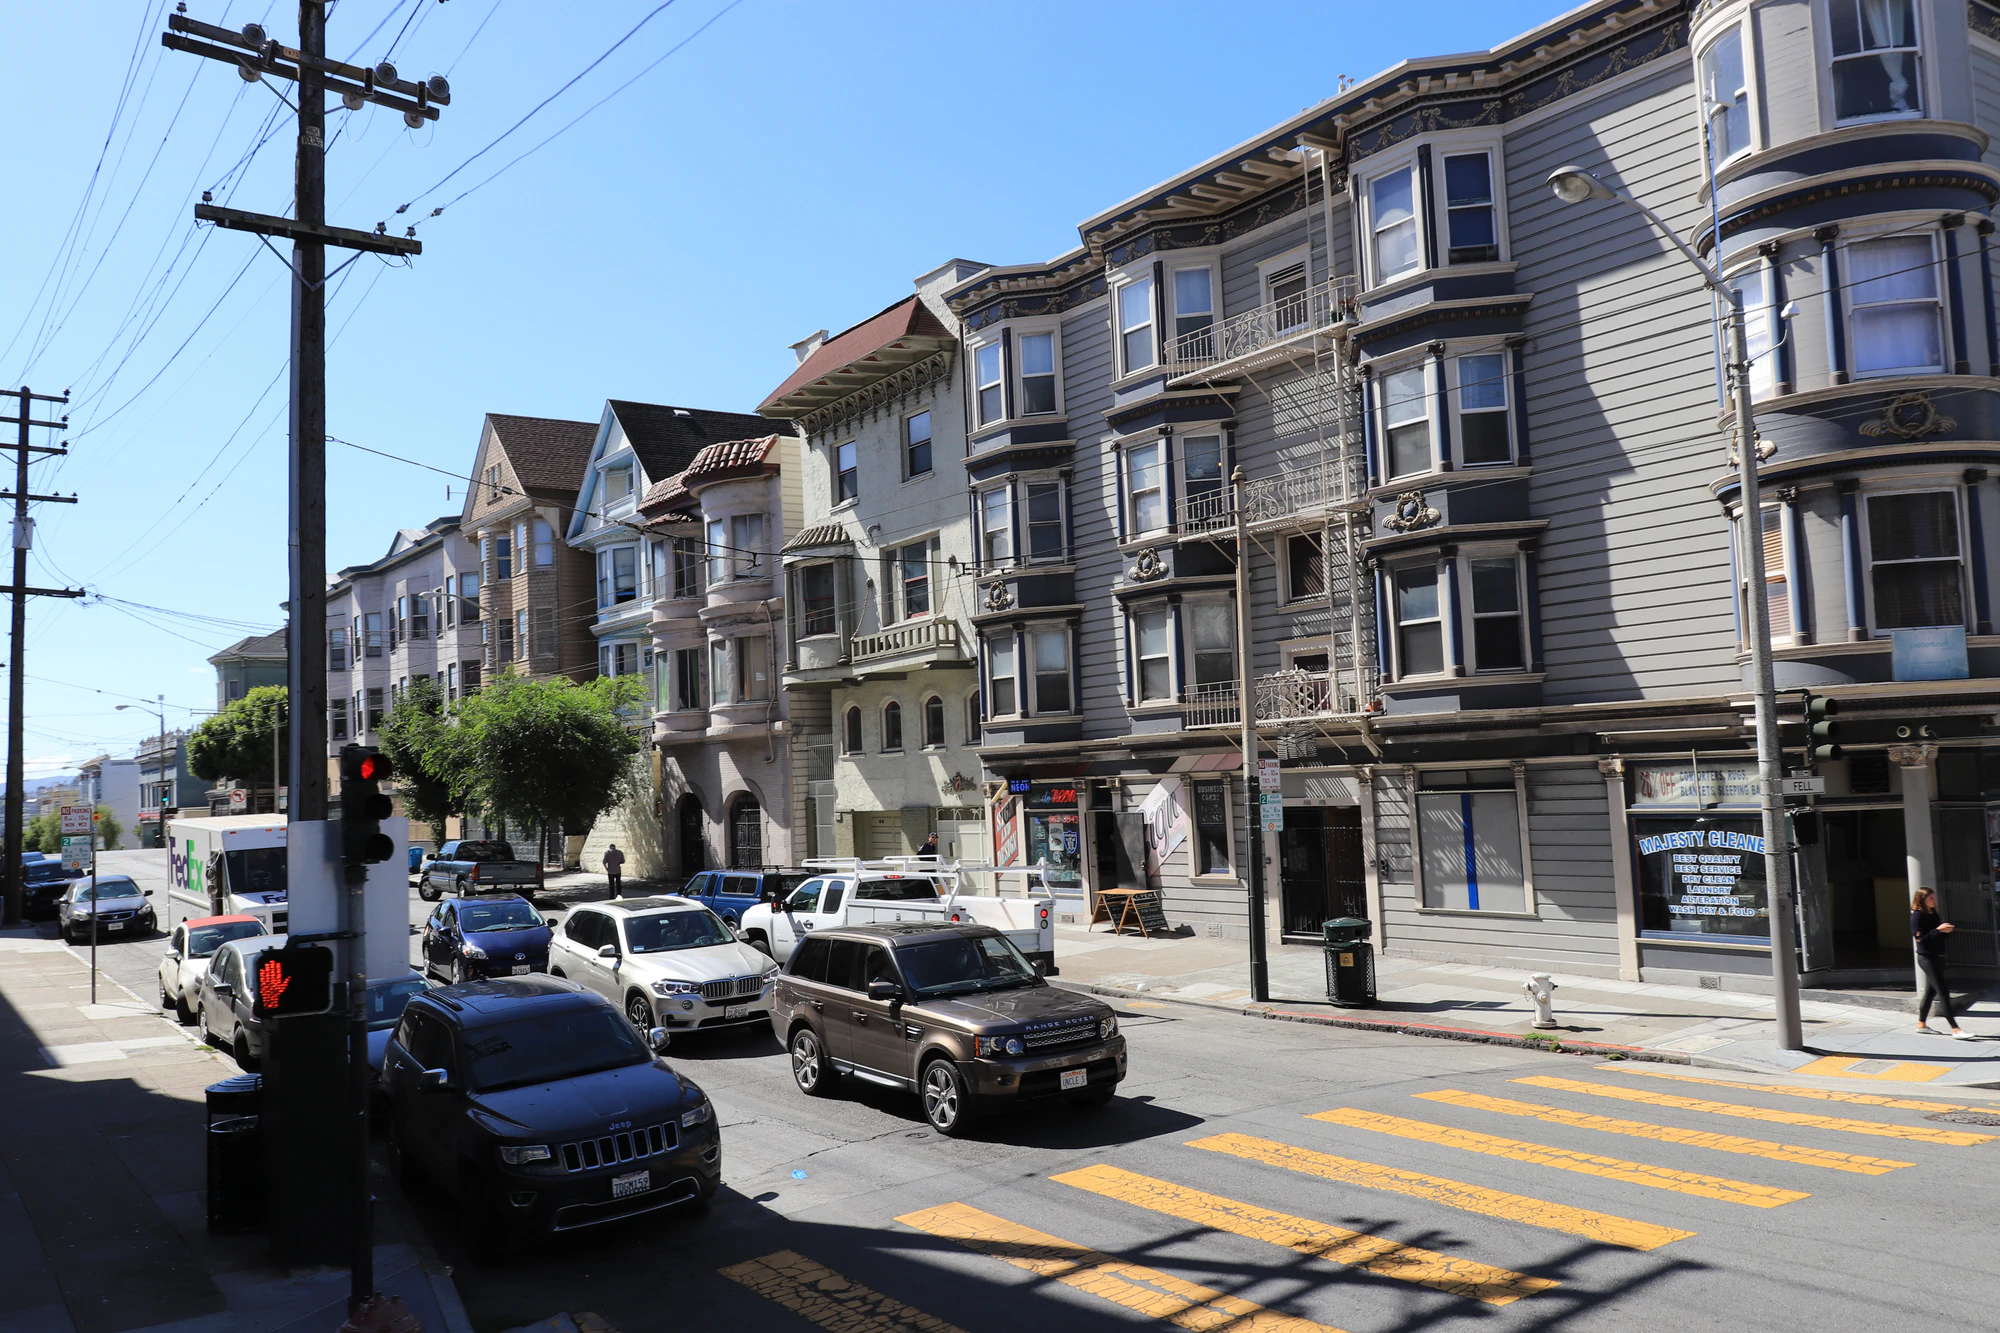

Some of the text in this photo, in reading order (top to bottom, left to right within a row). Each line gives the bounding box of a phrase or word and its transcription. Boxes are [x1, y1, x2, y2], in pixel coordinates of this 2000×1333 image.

[1680, 769, 1748, 782] COMORTERS, RUGS,
[1010, 783, 1030, 792] NEON
[1197, 785, 1223, 793] BUSINESS
[1640, 771, 1676, 798] 20% OFF
[1793, 781, 1813, 791] FELL
[1051, 789, 1077, 803] neon
[1717, 784, 1749, 797] SLEEPING
[1751, 784, 1762, 795] BA
[1201, 793, 1220, 801] CARDS
[1638, 830, 1765, 856] MAJESTY CLEANE
[1672, 854, 1741, 864] BEST QUALITY
[169, 836, 205, 894] FedEx
[1674, 864, 1742, 874] BEST SERVICE
[1681, 875, 1735, 884] DRY CLEAN
[1686, 885, 1732, 895] LAUNDRY
[1681, 895, 1740, 905] ALTERATION
[1668, 905, 1755, 917] WASH DRY & FOLD
[1025, 1015, 1096, 1031] RANGE ROVER
[1062, 1074, 1086, 1087] UNCLE S
[608, 1121, 632, 1131] Jeep
[613, 1177, 649, 1194] 7DGM159
